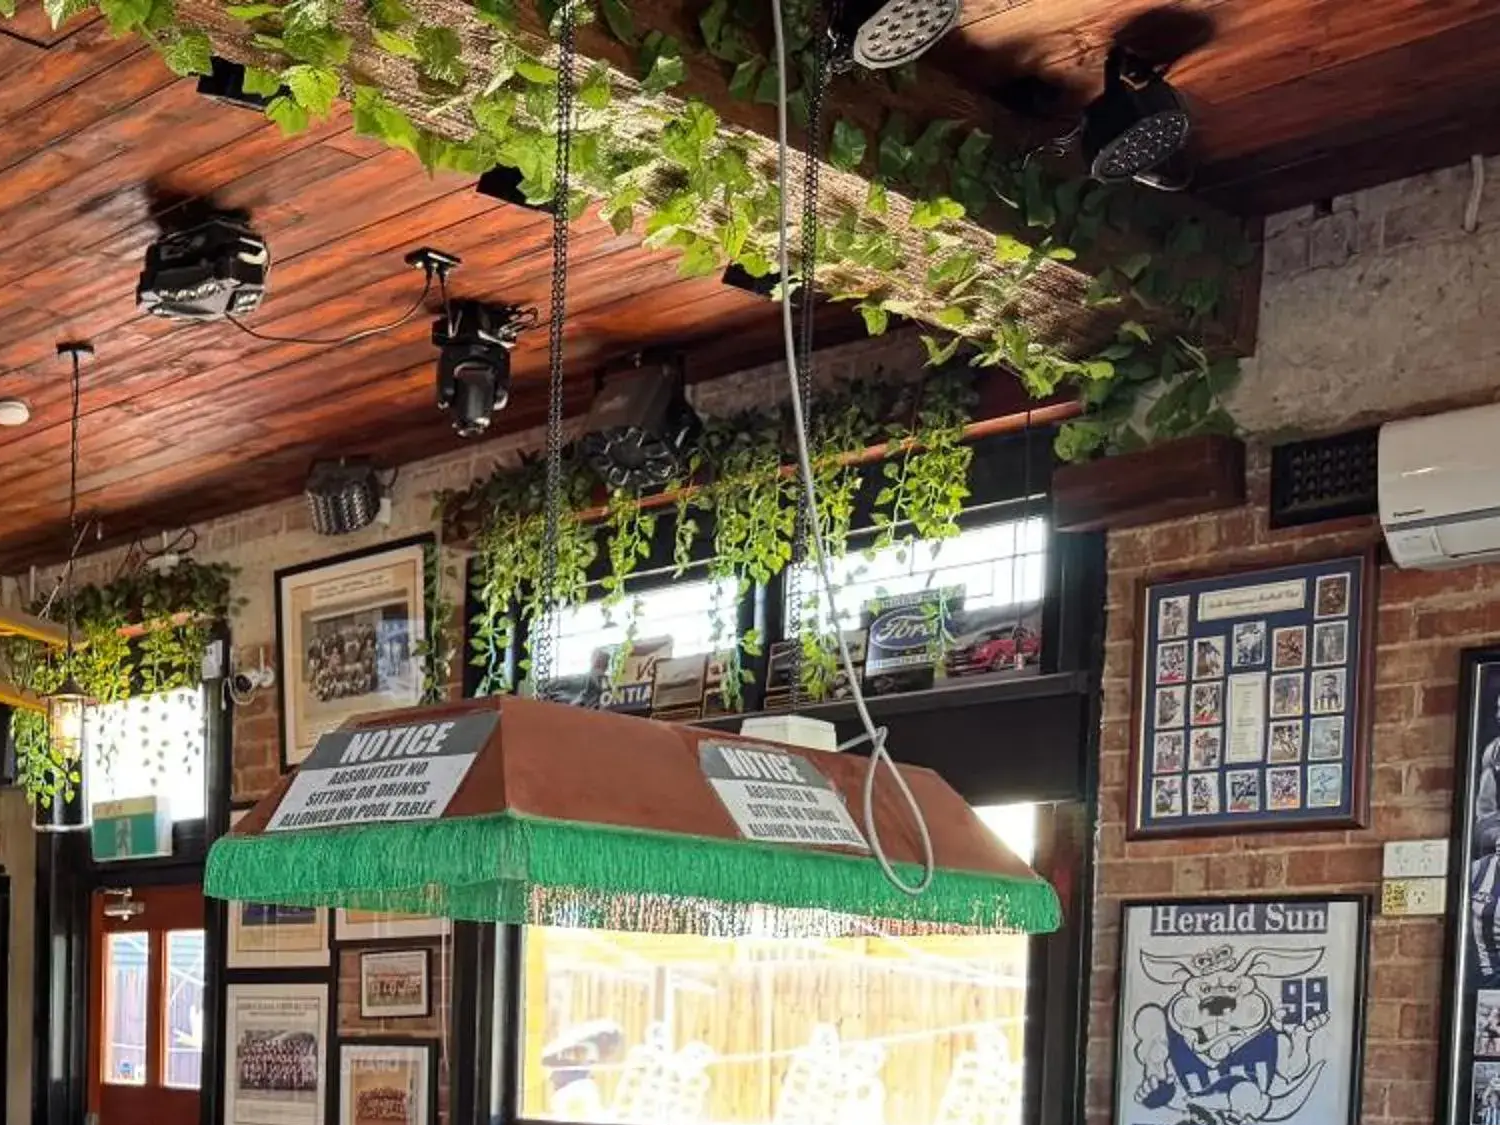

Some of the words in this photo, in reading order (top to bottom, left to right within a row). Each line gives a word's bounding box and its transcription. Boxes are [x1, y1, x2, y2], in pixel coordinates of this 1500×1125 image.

[340, 722, 455, 764] NOTICE
[328, 764, 406, 785] ABSOLUTELY
[406, 762, 428, 777] NO
[718, 747, 806, 782] NOTICE
[306, 789, 357, 807] SITTING
[356, 786, 376, 800] OR
[376, 781, 430, 799] DRINKS
[279, 808, 336, 827] ALLOWED
[336, 806, 354, 821] ON
[354, 803, 391, 819] POOL
[391, 800, 436, 816] TABLE
[1155, 903, 1256, 934] Herald
[1264, 903, 1326, 932] Sun
